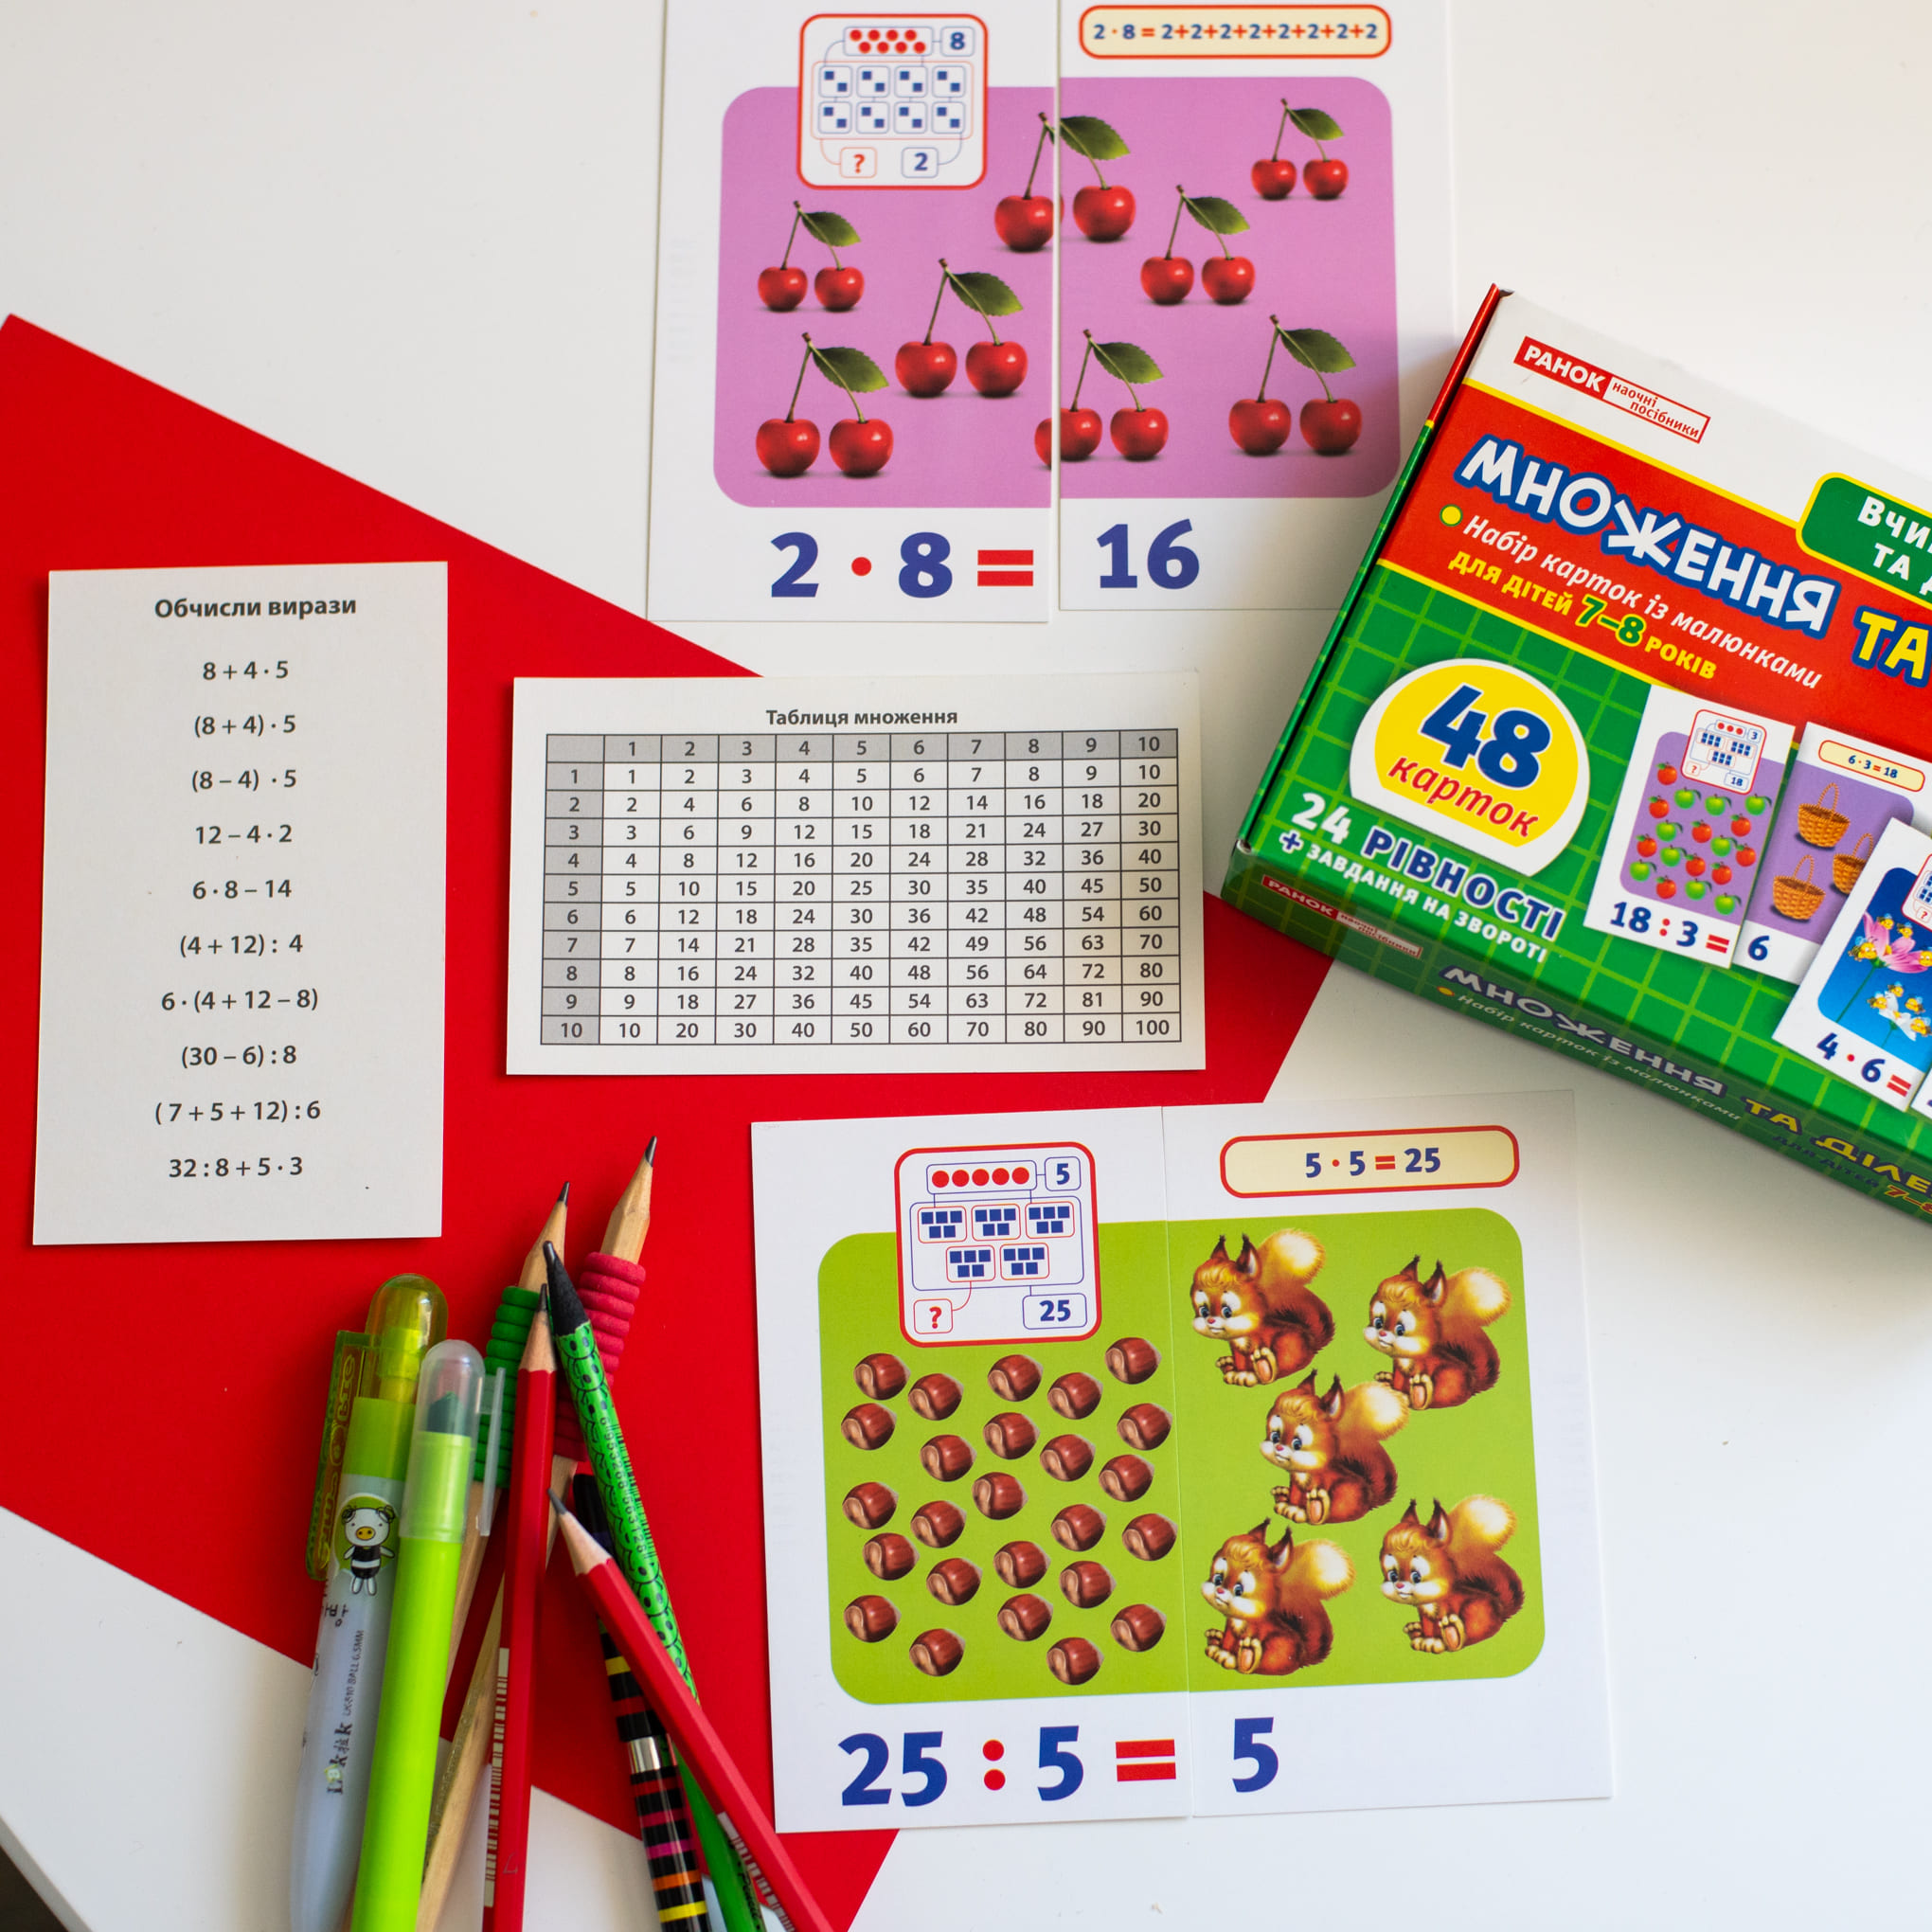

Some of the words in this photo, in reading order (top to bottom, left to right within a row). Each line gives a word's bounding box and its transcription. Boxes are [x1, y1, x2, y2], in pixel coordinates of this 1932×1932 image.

[950, 31, 965, 50] 8
[1094, 24, 1105, 40] 2
[1122, 24, 1136, 40] 8
[853, 153, 866, 173] ?
[914, 152, 928, 171] 2
[1523, 345, 1606, 393] РАНОК
[1612, 382, 1658, 408] наочні
[1629, 400, 1700, 438] посібники
[770, 531, 819, 598] 2
[898, 531, 954, 599] 8
[1096, 518, 1201, 590] 16
[1458, 438, 1837, 634] МНОЖЕННЯ
[1857, 609, 1930, 681] ТА
[153, 599, 261, 619] Обчисли
[268, 599, 357, 621] вирази
[1448, 551, 1503, 584] ДЛЯ
[1501, 574, 1574, 616] ДІТЕЙ
[1644, 635, 1718, 680] РОКІВ
[1463, 514, 1539, 564] Набір
[1541, 553, 1643, 609] карток
[1644, 594, 1669, 619] із
[1671, 612, 1823, 689] малюнками
[766, 708, 849, 727] Таблиця
[854, 712, 957, 724] множення
[628, 741, 635, 757] 1
[684, 740, 695, 757] 2
[742, 740, 752, 756] 3
[797, 740, 810, 756] 4
[855, 740, 867, 756] 5
[913, 739, 924, 755] 6
[970, 738, 982, 755] 7
[1028, 738, 1039, 754] 8
[1084, 736, 1097, 753] 9
[1137, 735, 1160, 751] 10
[1418, 683, 1552, 790] 48
[1751, 731, 1759, 741] 3
[570, 768, 578, 784] 1
[628, 768, 635, 784] 1
[684, 768, 695, 784] 2
[742, 768, 752, 783] 3
[797, 768, 810, 783] 4
[855, 767, 867, 783] 5
[913, 767, 924, 782] 6
[971, 766, 981, 782] 7
[1028, 765, 1039, 781] 8
[1085, 765, 1097, 780] 9
[1138, 763, 1160, 779] 10
[1730, 776, 1744, 787] 18
[1884, 766, 1898, 778] 18
[1387, 757, 1539, 838] карток
[1291, 792, 1352, 845] 24
[1361, 825, 1567, 942] РІВНОСТІ
[567, 880, 578, 896] 5
[625, 881, 635, 896] 5
[678, 880, 700, 896] 10
[735, 880, 757, 896] 15
[792, 880, 815, 896] 20
[850, 880, 872, 895] 25
[907, 879, 930, 895] 30
[965, 879, 988, 894] 35
[1022, 878, 1046, 894] 40
[1080, 878, 1103, 893] 45
[1138, 876, 1162, 892] 50
[1268, 880, 1333, 916] РАНОК
[1306, 844, 1420, 905] ЗАВДАННЯ
[1422, 896, 1451, 921] НА
[1454, 910, 1547, 963] ЗВОРОТІ
[566, 937, 578, 953] 7
[624, 937, 635, 953] 7
[677, 937, 700, 953] 14
[734, 937, 754, 953] 21
[792, 937, 814, 952] 28
[850, 936, 872, 952] 35
[907, 936, 930, 952] 42
[964, 936, 989, 951] 49
[1023, 935, 1046, 951] 56
[1081, 934, 1103, 950] 63
[1139, 933, 1162, 949] 70
[1610, 902, 1652, 933] 18
[1676, 921, 1699, 947] 3
[1747, 935, 1770, 961] 6
[1443, 967, 1725, 1096] МНОЖЕННЯ
[1745, 1098, 1799, 1133] ТА
[1458, 994, 1515, 1024] Набір
[1519, 1021, 1600, 1059] карток
[1624, 1064, 1741, 1120] малюнками
[1816, 1032, 1838, 1061] 4
[1861, 1058, 1886, 1082] 6
[1056, 1163, 1070, 1185] 5
[1305, 1153, 1322, 1178] 5
[1350, 1151, 1366, 1176] 5
[1404, 1147, 1441, 1173] 25
[929, 1306, 942, 1329] ?
[1039, 1299, 1071, 1322] 25
[837, 1730, 948, 1808] 25
[1037, 1725, 1084, 1801] 5
[1231, 1716, 1279, 1793] 5
